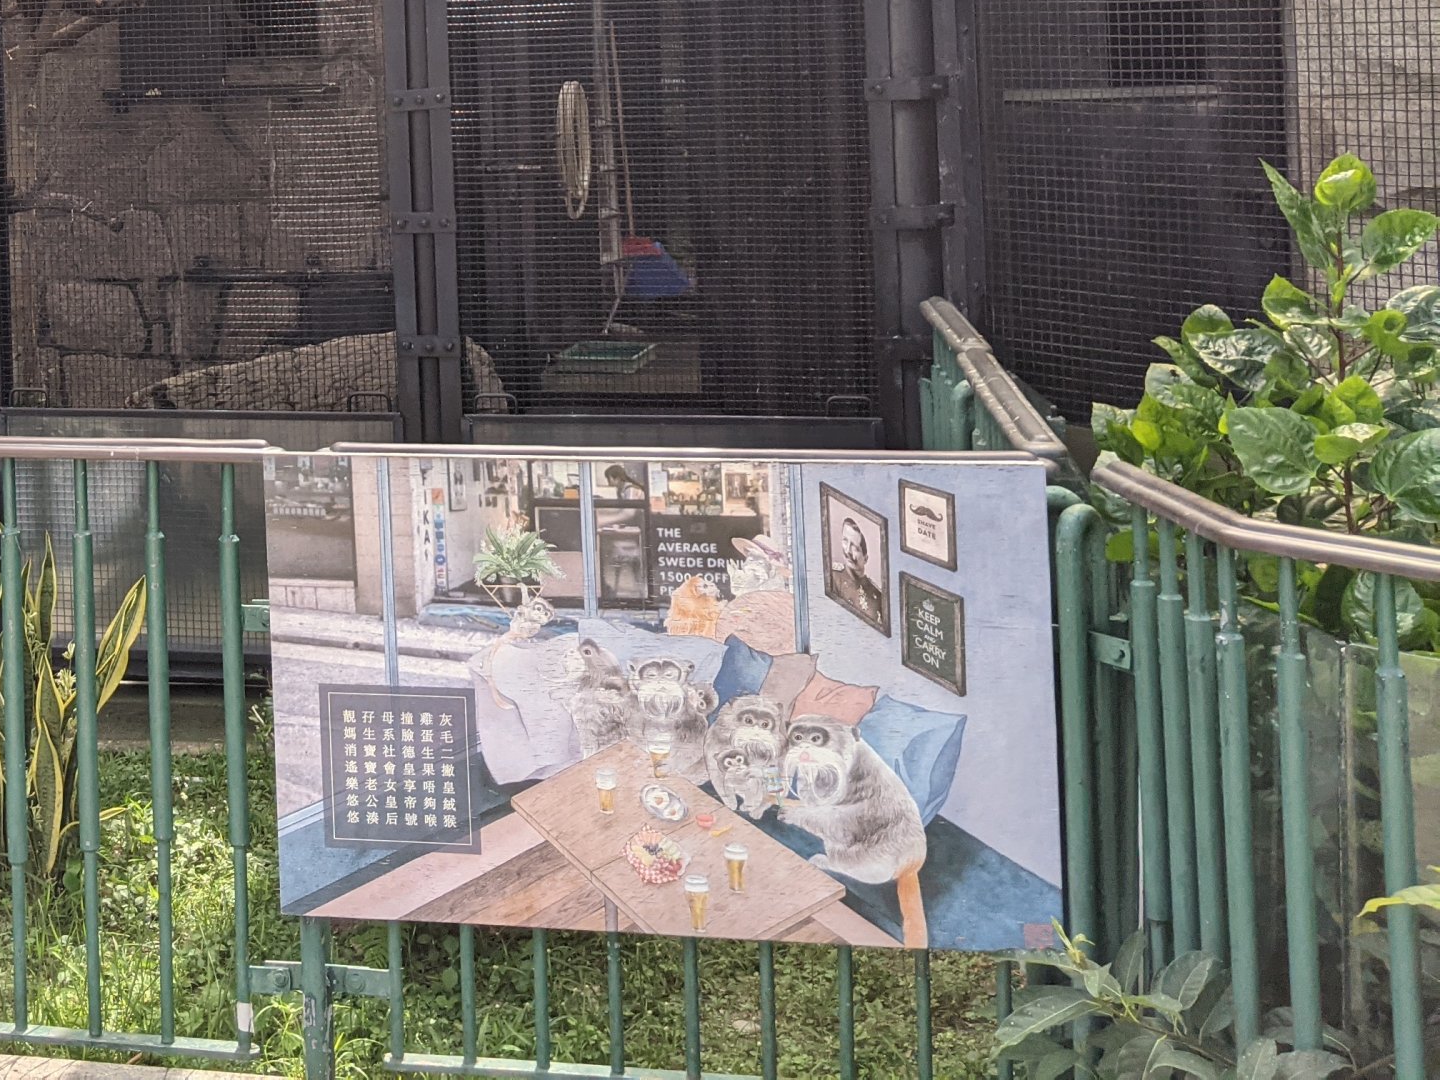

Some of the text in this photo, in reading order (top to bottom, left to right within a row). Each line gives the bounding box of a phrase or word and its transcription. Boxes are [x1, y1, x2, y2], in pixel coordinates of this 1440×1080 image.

[657, 528, 681, 538] THE
[918, 528, 936, 540] DATE
[657, 542, 717, 553] AVERAGE
[658, 557, 704, 568] SWEDE
[660, 571, 692, 582] 1500
[918, 608, 941, 626] KEEP
[916, 620, 944, 640] CALM
[924, 634, 936, 643] AND
[915, 637, 946, 660] CARRY
[922, 652, 939, 669] ON
[381, 711, 398, 825] 母系社會女皇后
